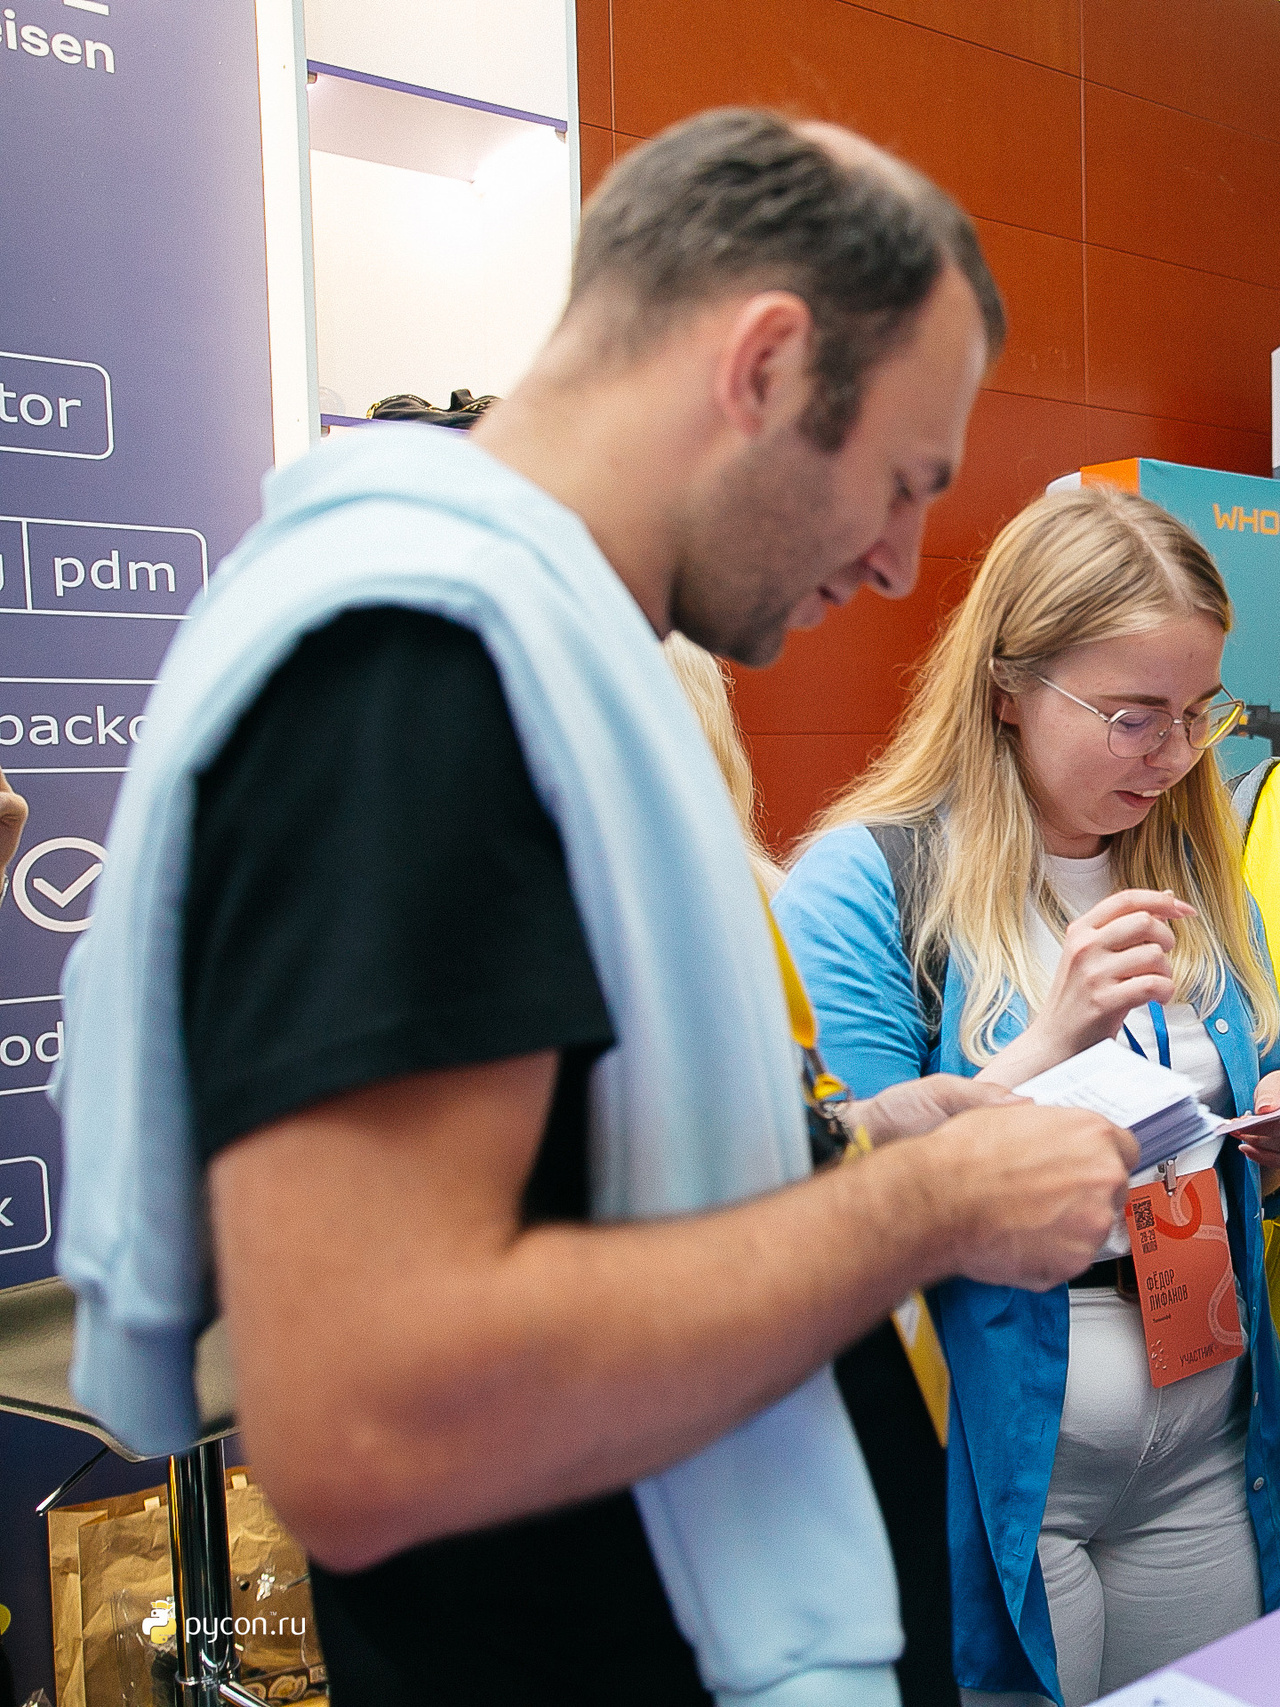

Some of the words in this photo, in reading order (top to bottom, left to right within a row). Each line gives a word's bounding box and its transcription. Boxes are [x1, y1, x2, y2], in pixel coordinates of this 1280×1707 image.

[0, 8, 116, 74] isen
[54, 550, 176, 597] pdm
[1146, 1269, 1175, 1291] ФЁДОР
[1180, 1343, 1214, 1366] УЧАСТНИК
